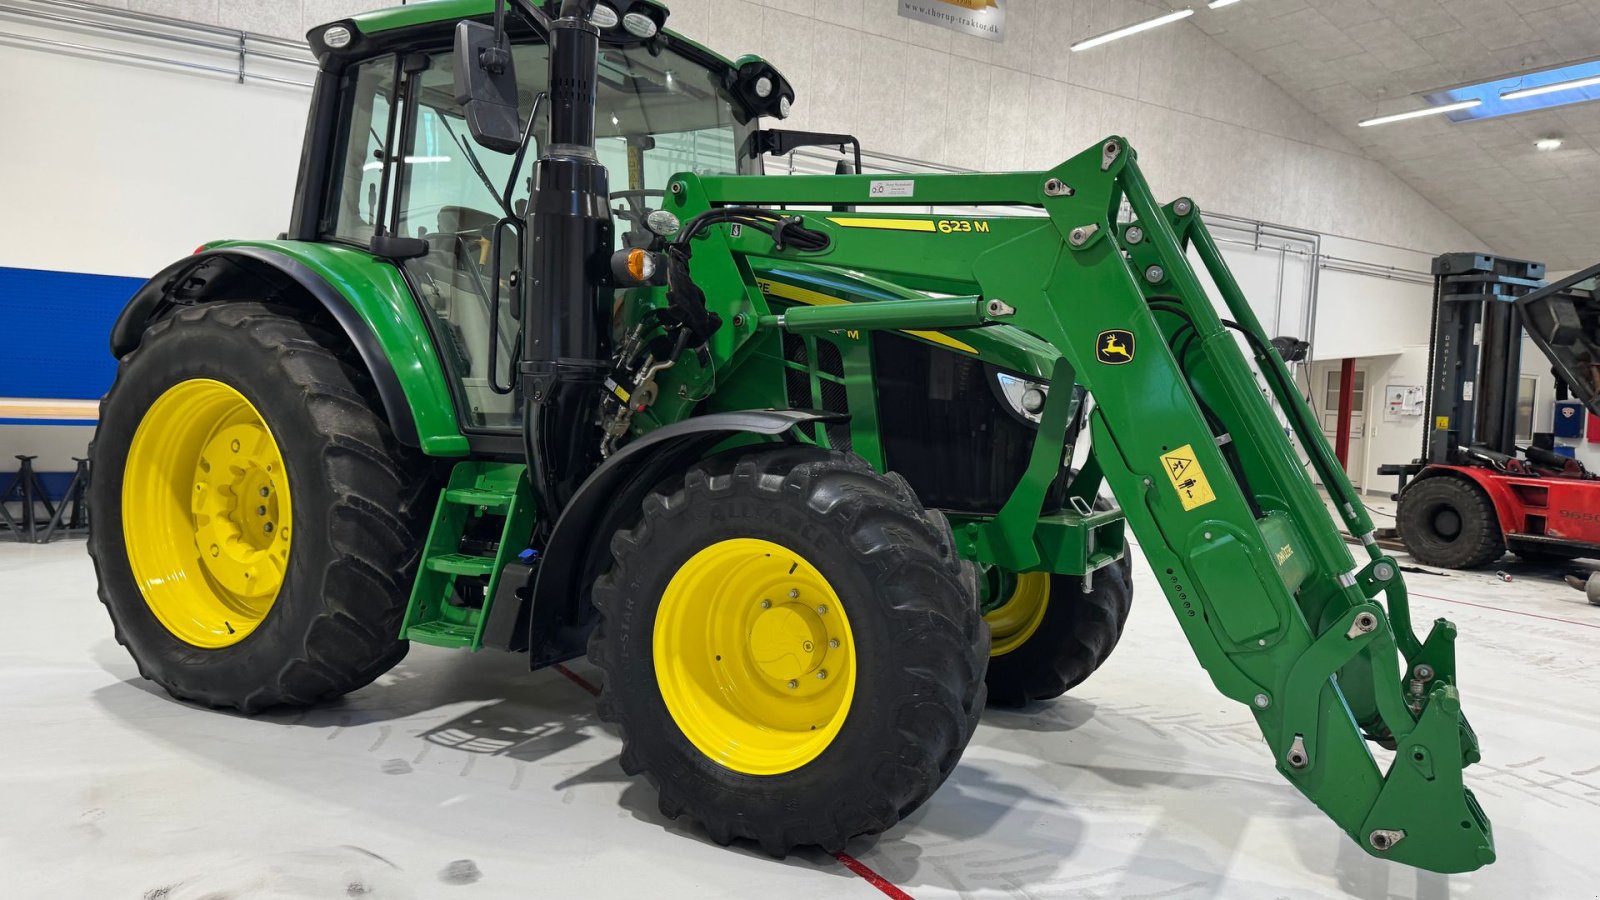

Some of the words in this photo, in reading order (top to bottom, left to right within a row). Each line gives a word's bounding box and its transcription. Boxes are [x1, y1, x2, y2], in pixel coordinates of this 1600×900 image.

[904, 2, 999, 33] www.thorup-traktor.dk
[937, 220, 971, 233] 623
[974, 221, 990, 233] M
